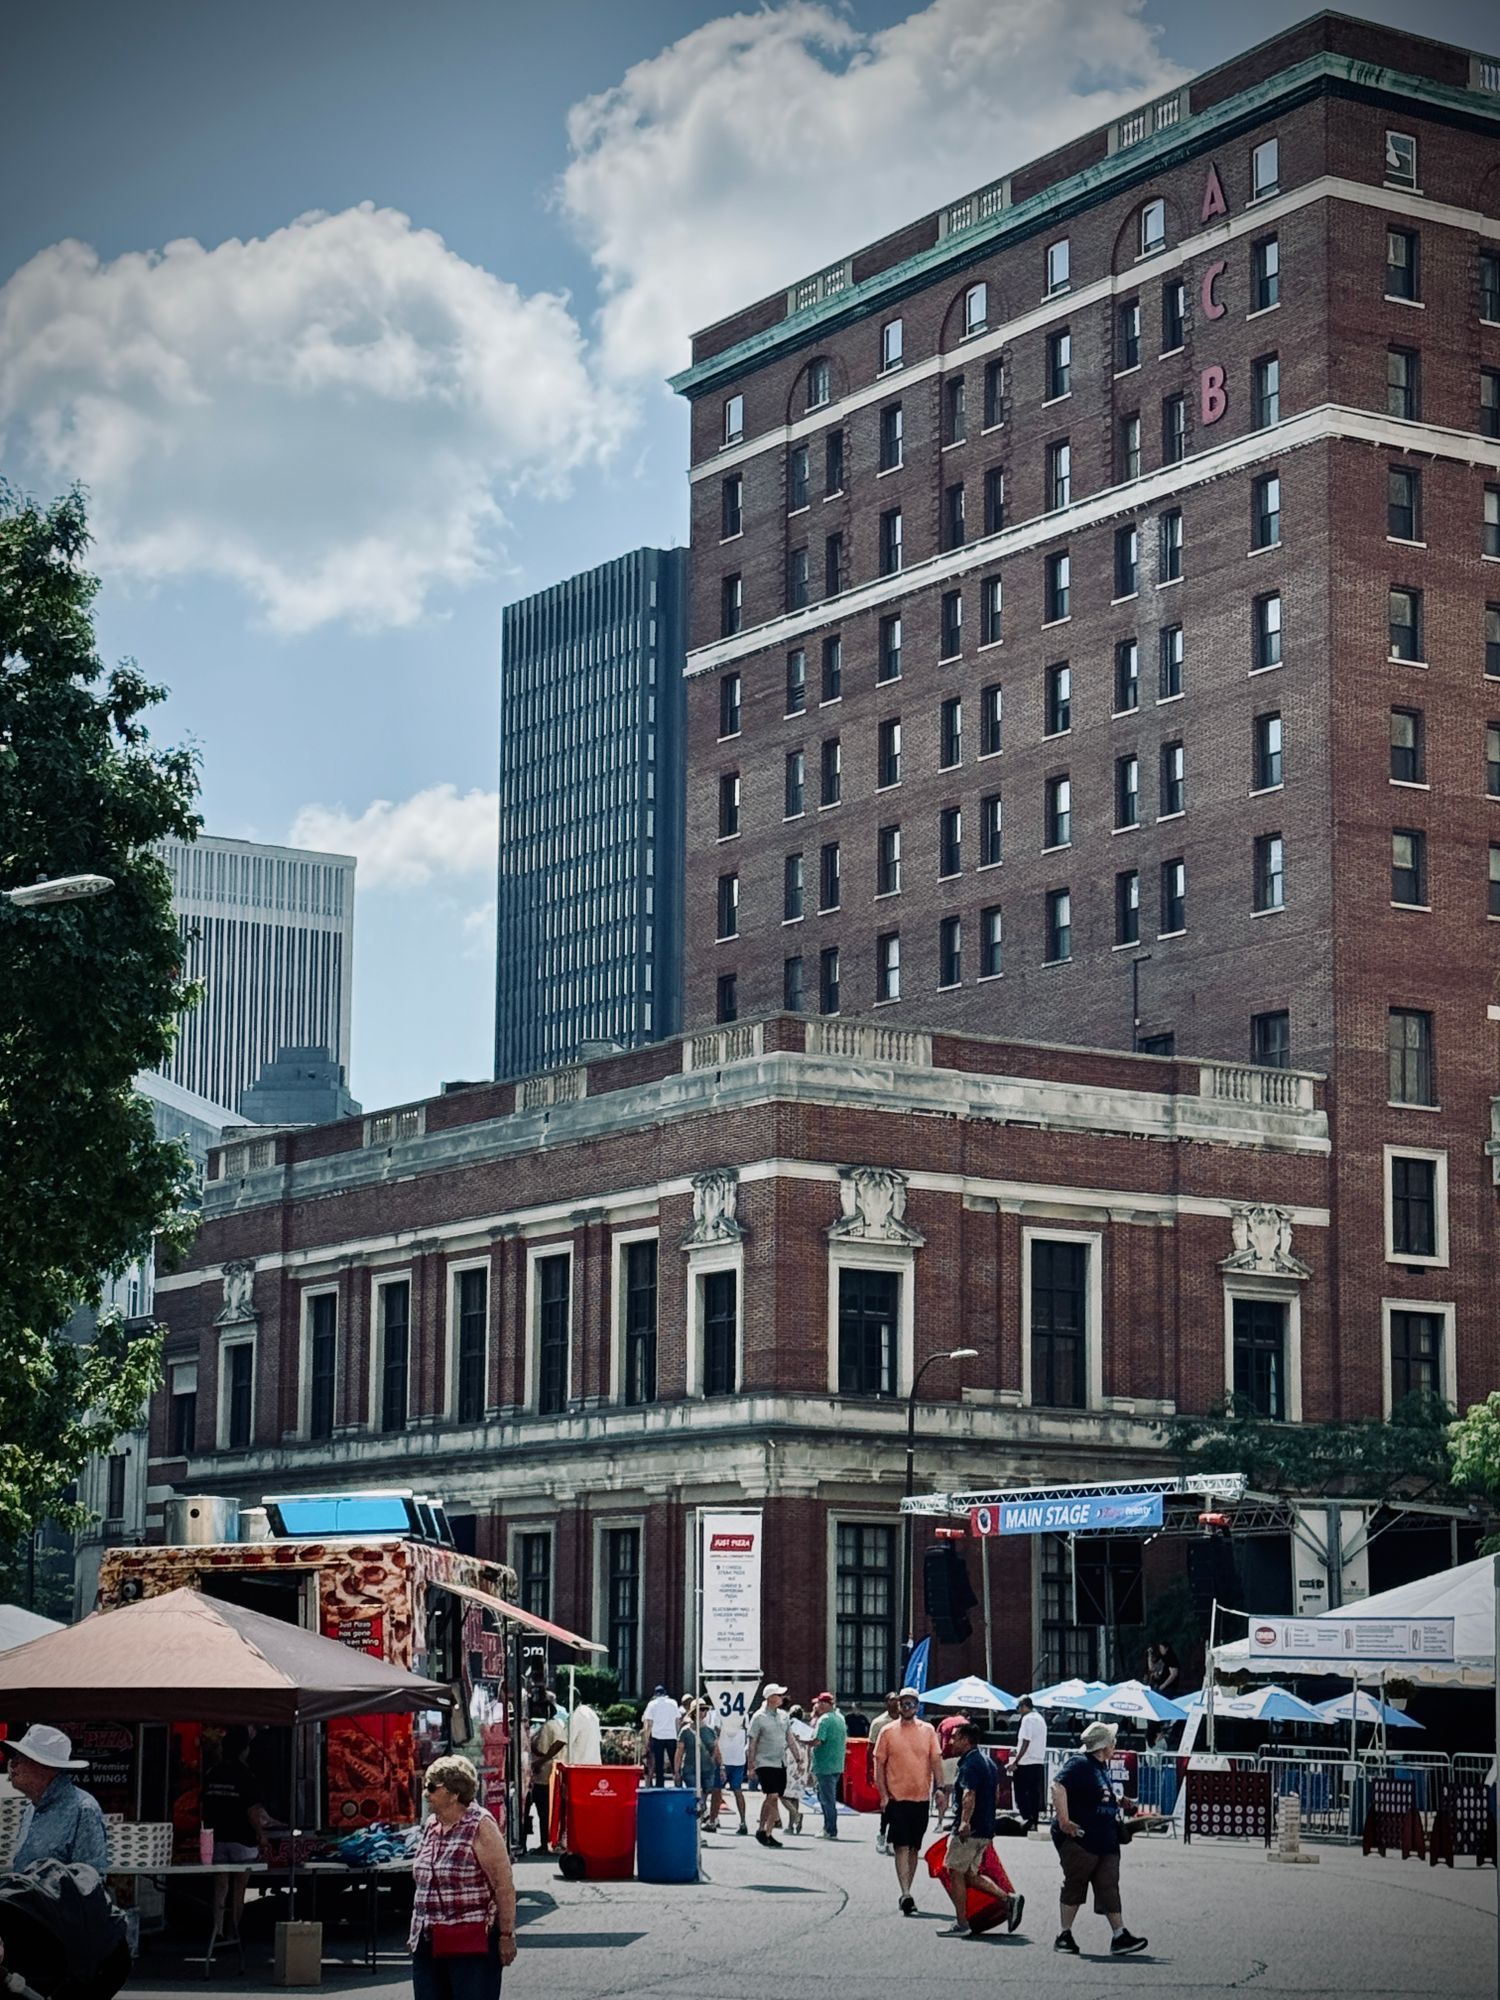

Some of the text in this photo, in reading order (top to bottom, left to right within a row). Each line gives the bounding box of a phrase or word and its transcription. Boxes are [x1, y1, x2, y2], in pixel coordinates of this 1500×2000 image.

[1005, 1508, 1043, 1529] MAIN
[1045, 1504, 1090, 1525] STAGE
[720, 1692, 745, 1717] 34
[92, 1761, 130, 1771] Premier
[93, 1774, 128, 1783] WINGS
